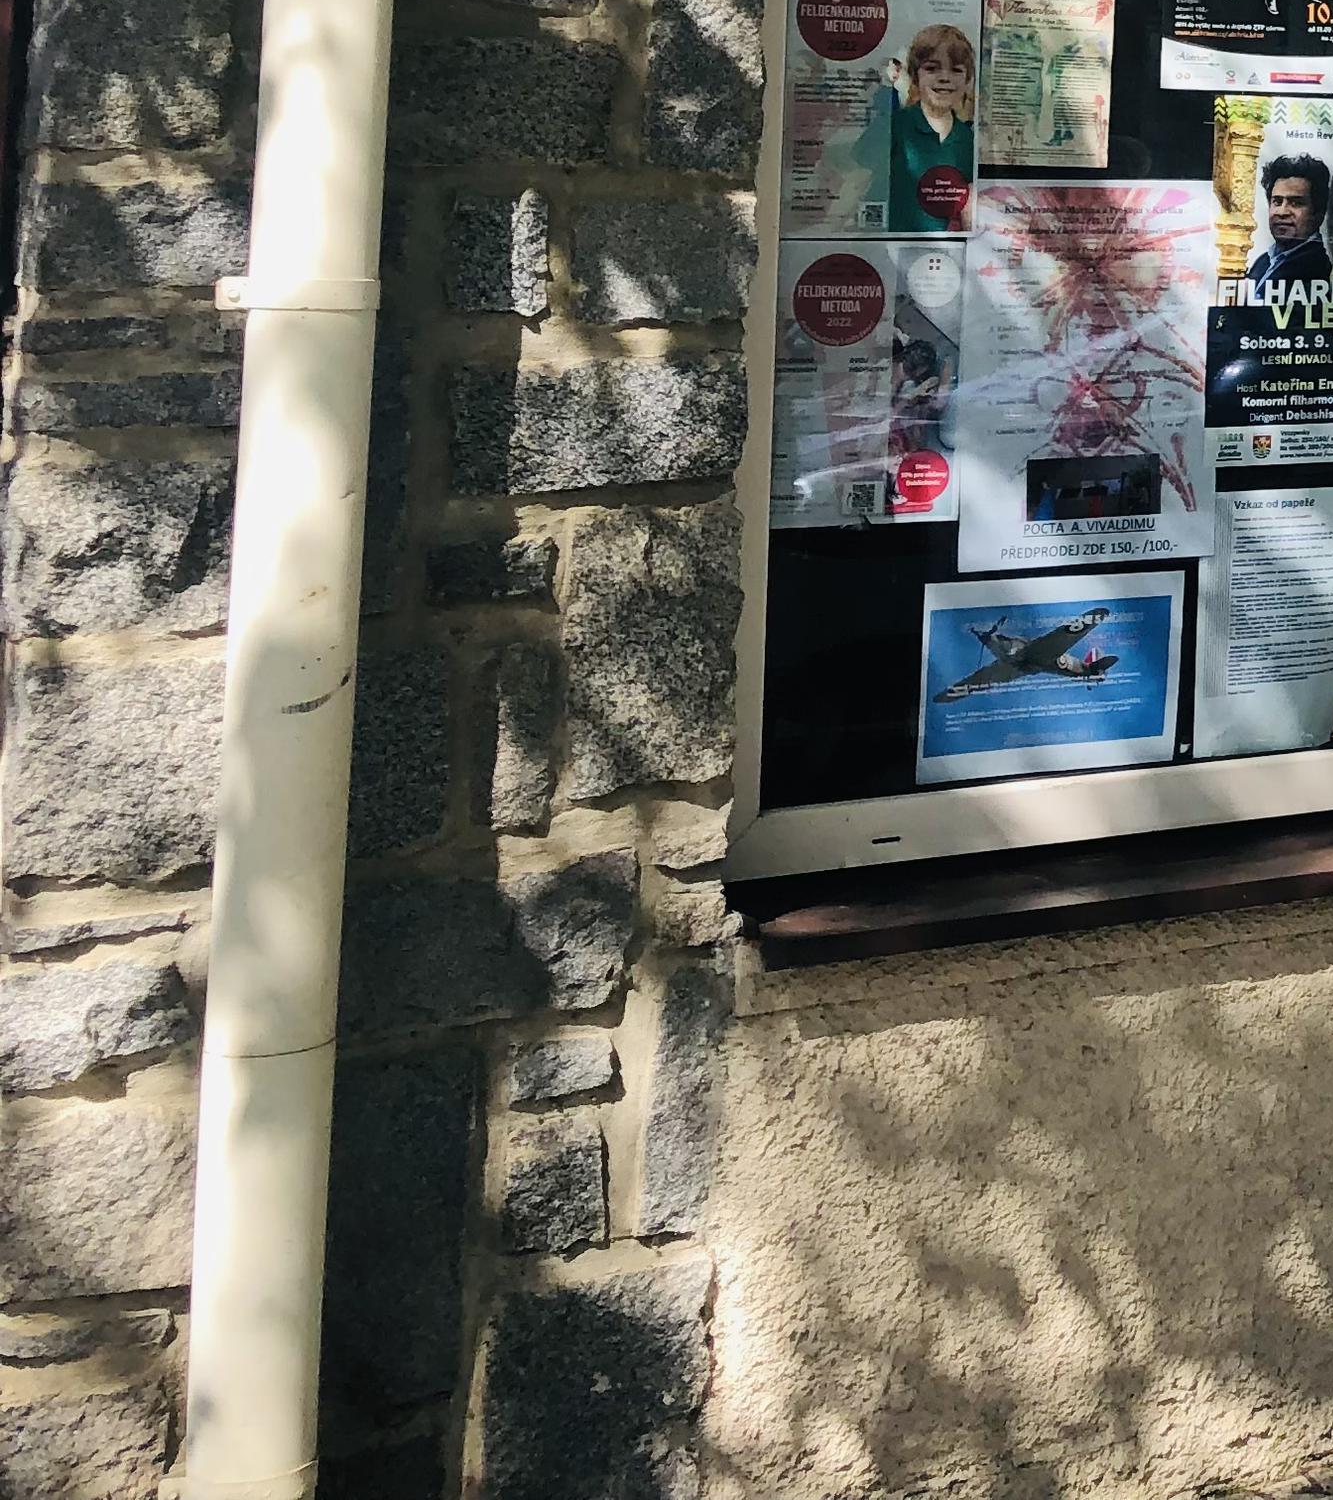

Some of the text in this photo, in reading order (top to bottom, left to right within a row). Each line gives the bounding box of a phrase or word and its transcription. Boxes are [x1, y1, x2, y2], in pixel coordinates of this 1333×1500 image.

[800, 3, 886, 20] FELDENKRAISOVA
[823, 19, 865, 34] METODA
[1285, 129, 1314, 140] Město
[797, 284, 882, 299] FELDENKRAISOVA
[820, 299, 861, 313] METODA
[825, 317, 852, 328] 2022
[1271, 303, 1294, 330] V
[1239, 335, 1291, 350] Sobota
[1294, 335, 1309, 349] 3.
[1314, 335, 1330, 348] 9.
[1261, 351, 1293, 366] LESNÍ
[1236, 382, 1257, 393] Host
[1260, 378, 1314, 393] Kateřina
[1242, 395, 1287, 408] Komorní
[1249, 410, 1284, 423] Dirigent
[1234, 497, 1316, 510] Vzkaz od papeže
[1023, 517, 1156, 535] POCTA A. VIVALDIMU
[1000, 545, 1079, 559] PŘEDPRODEJ
[1082, 542, 1107, 556] ZDE
